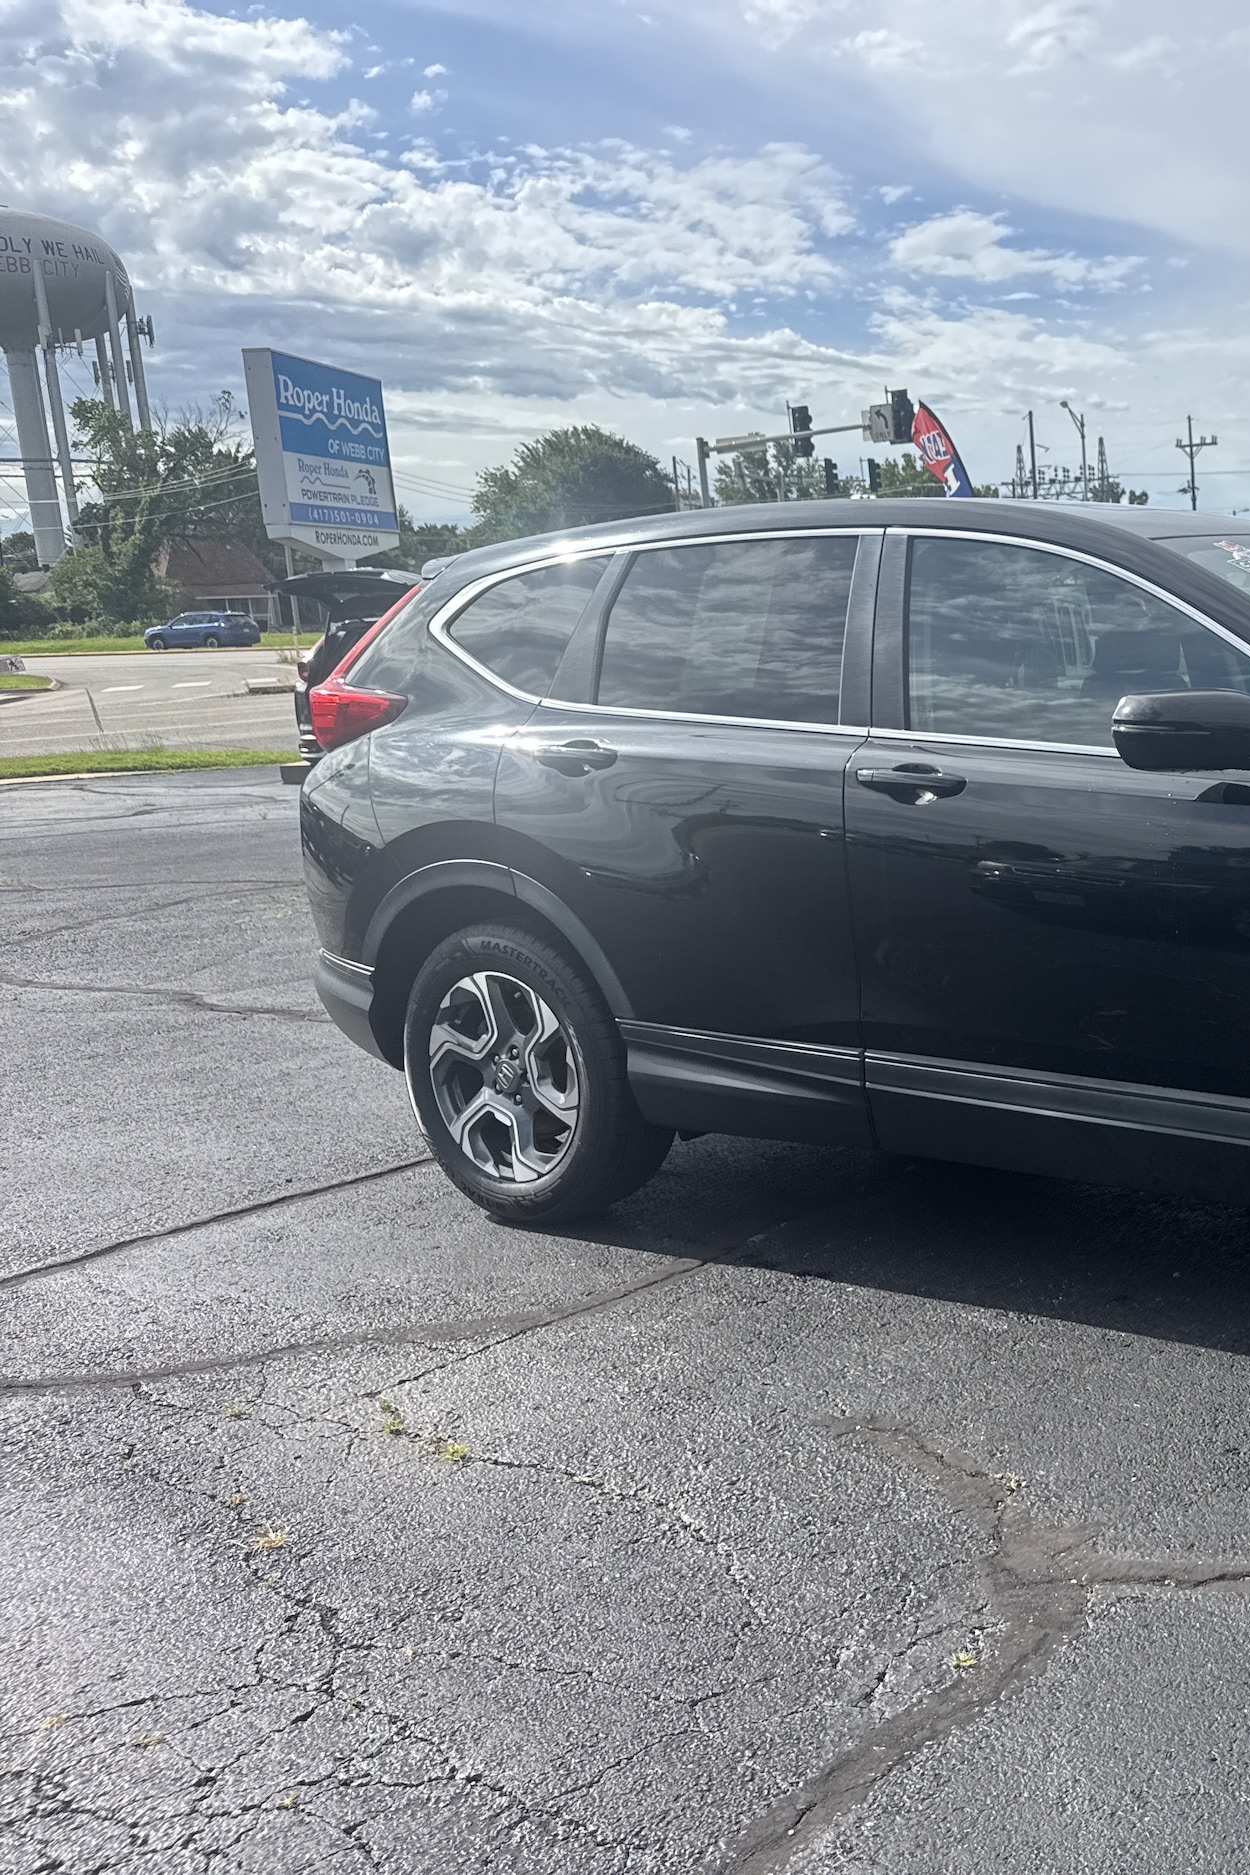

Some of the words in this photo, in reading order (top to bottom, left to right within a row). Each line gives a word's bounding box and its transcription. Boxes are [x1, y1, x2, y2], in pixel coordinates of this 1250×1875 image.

[41, 239, 68, 258] WE
[72, 243, 105, 265] HAIL
[43, 259, 79, 279] CITY
[278, 374, 329, 415] Roper
[331, 387, 382, 425] Honda
[875, 430, 891, 440] ONLY
[328, 439, 341, 454] OF
[341, 441, 366, 459] WEBB
[366, 446, 385, 462] CITY
[297, 458, 322, 476] Roper
[323, 462, 350, 479] Honda
[301, 488, 350, 504] POWERTRAIN
[350, 494, 380, 508] PLEDGE
[308, 507, 380, 525] (417)501-0904
